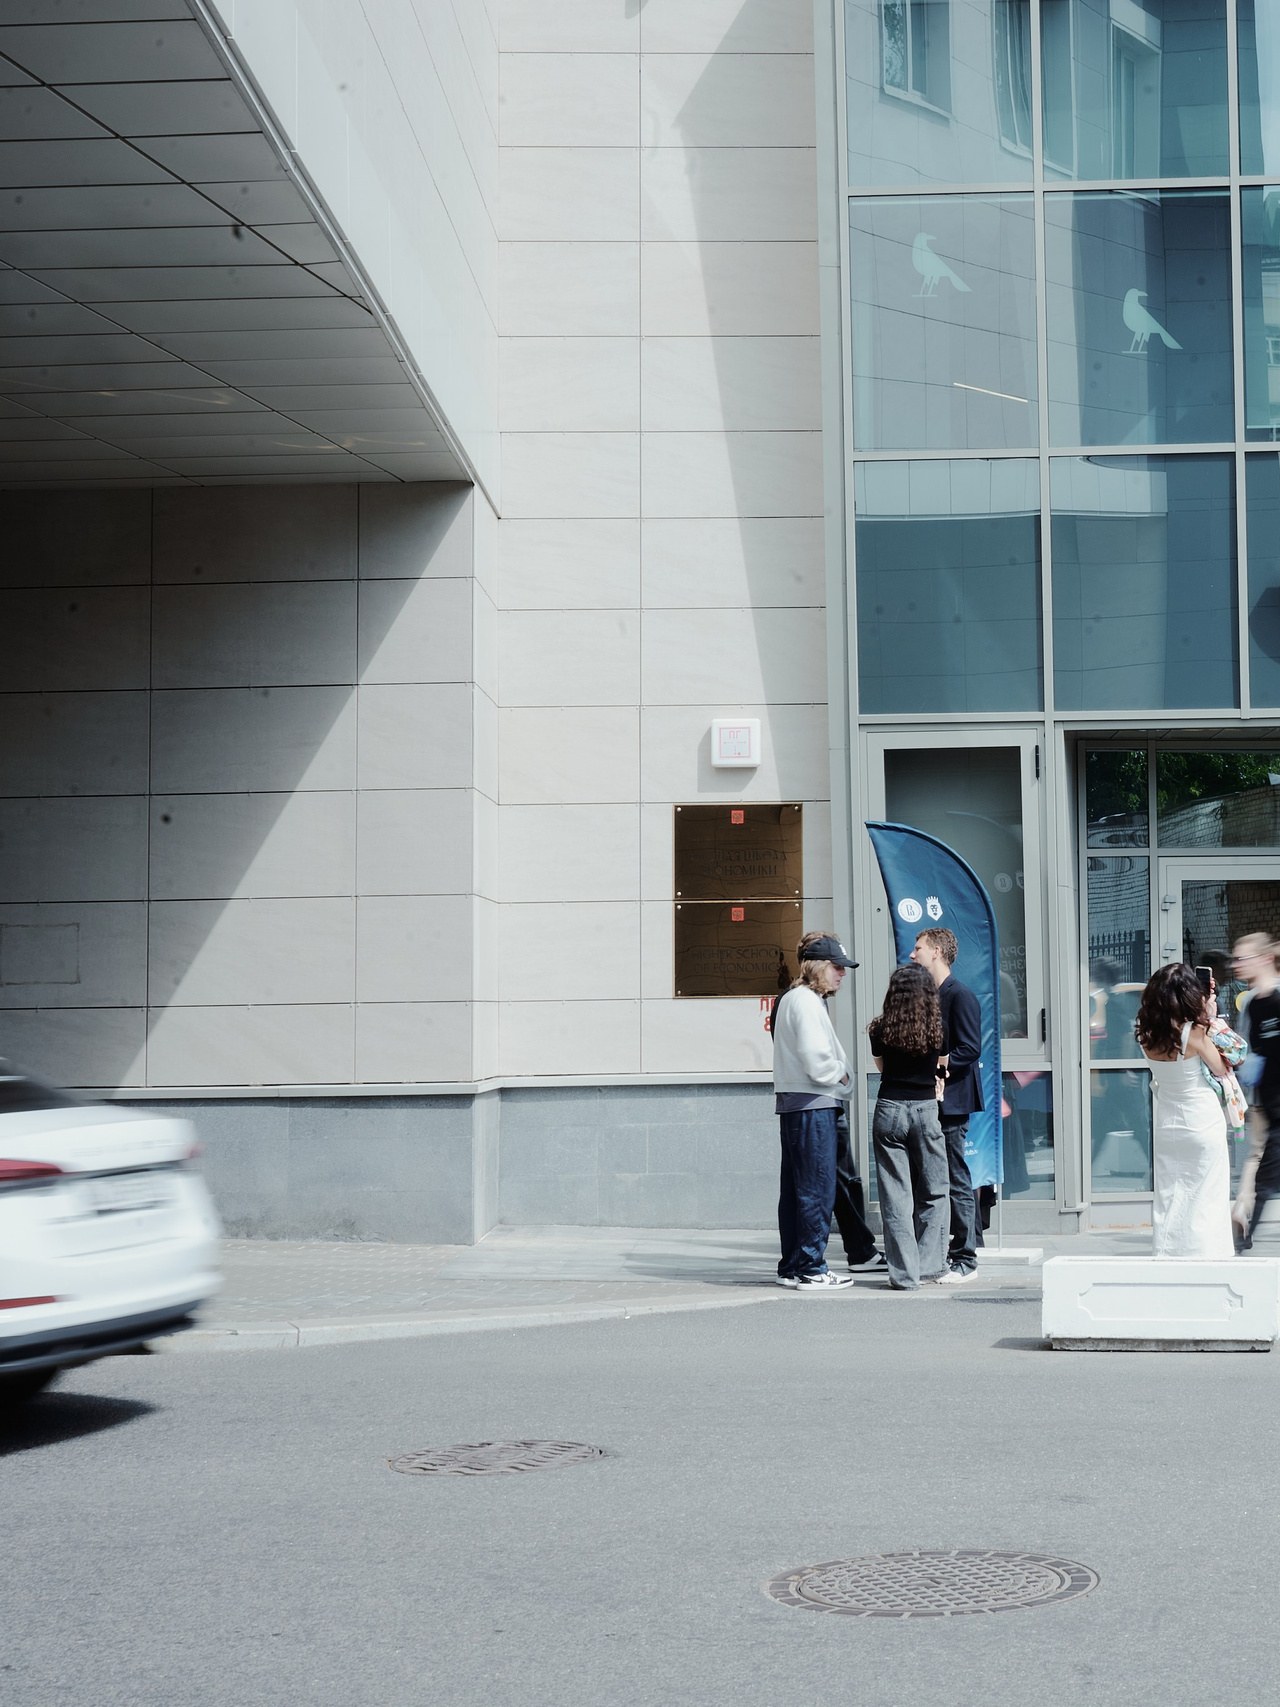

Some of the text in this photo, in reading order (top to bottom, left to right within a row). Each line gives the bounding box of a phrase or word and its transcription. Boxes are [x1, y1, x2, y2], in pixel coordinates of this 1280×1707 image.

[692, 948, 733, 960] HIGHER
[695, 962, 781, 974] OF ECONOMICS
